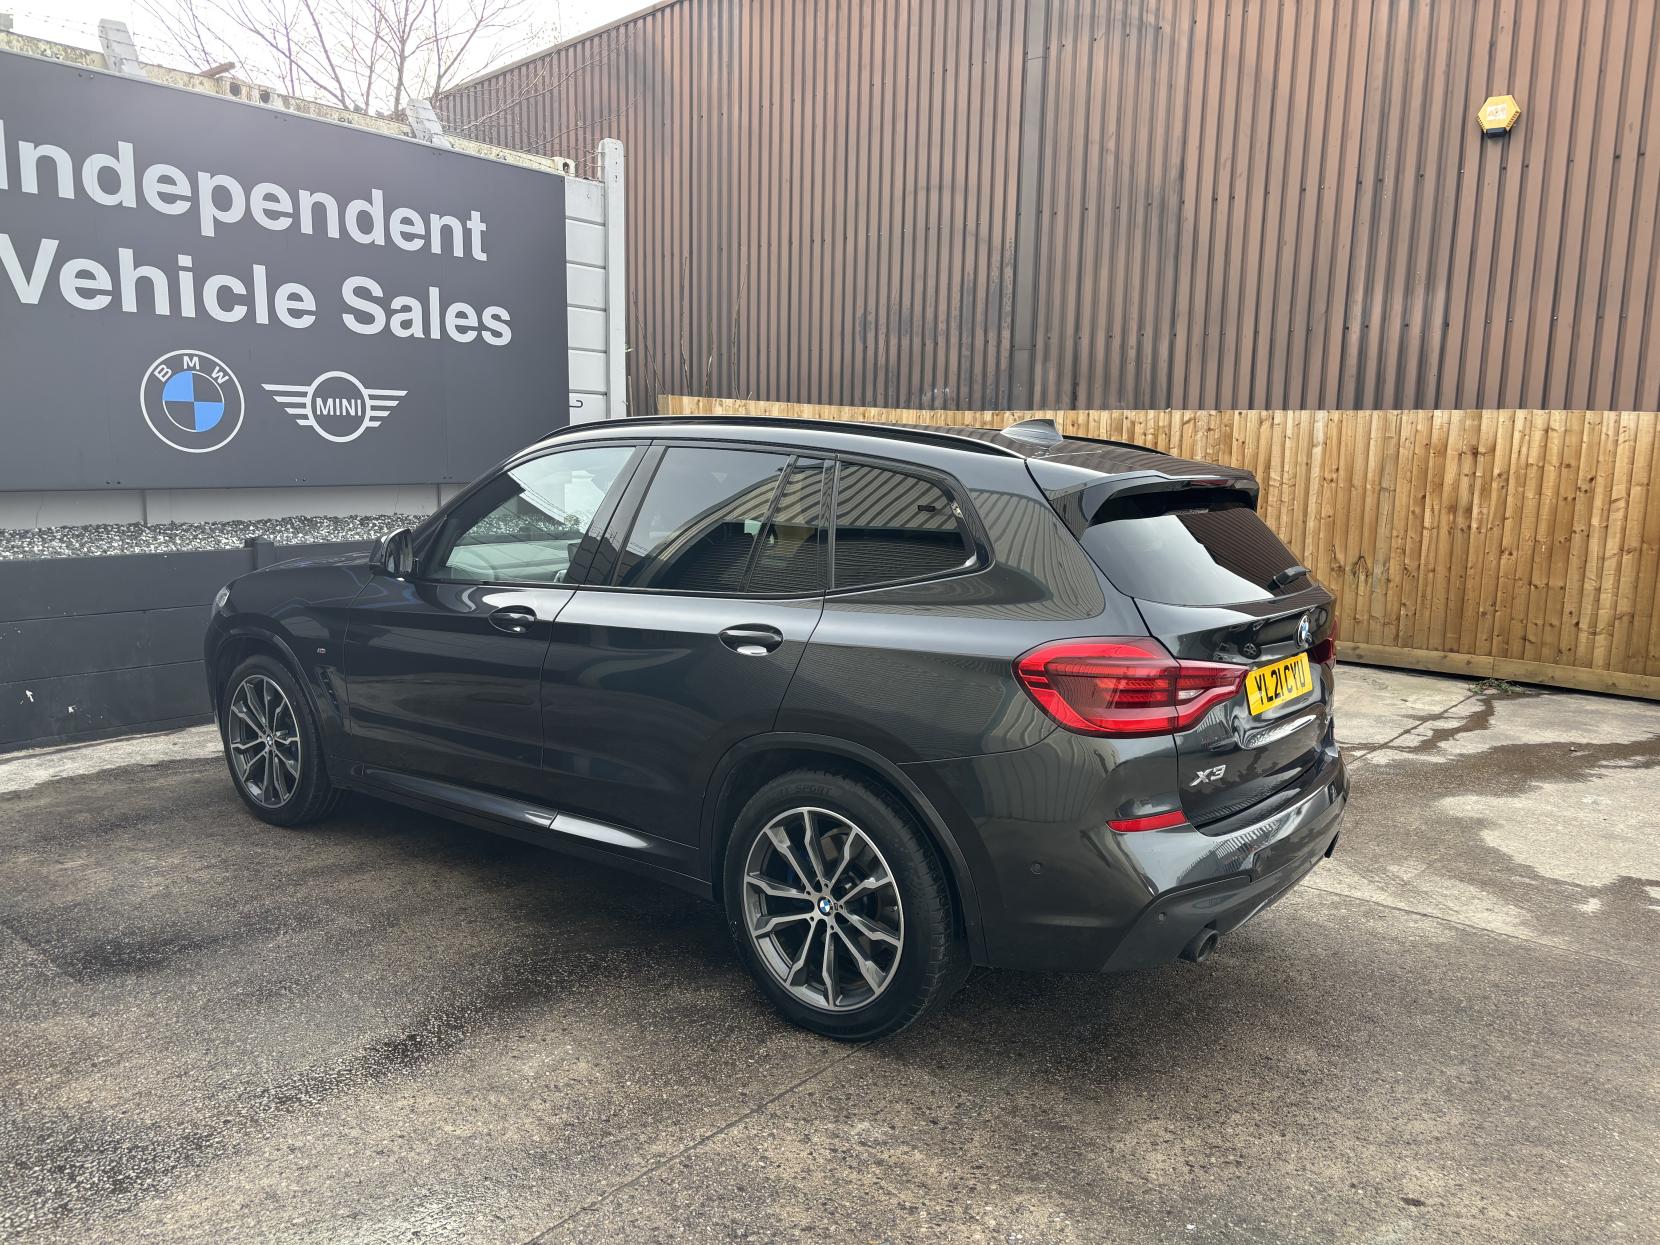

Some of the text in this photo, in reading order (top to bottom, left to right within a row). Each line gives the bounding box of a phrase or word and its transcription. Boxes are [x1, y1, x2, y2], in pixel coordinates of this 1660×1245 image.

[0, 232, 512, 347] Vehicle Sales
[153, 355, 229, 385] BMW
[315, 396, 363, 418] MINI
[1189, 764, 1226, 787] X3
